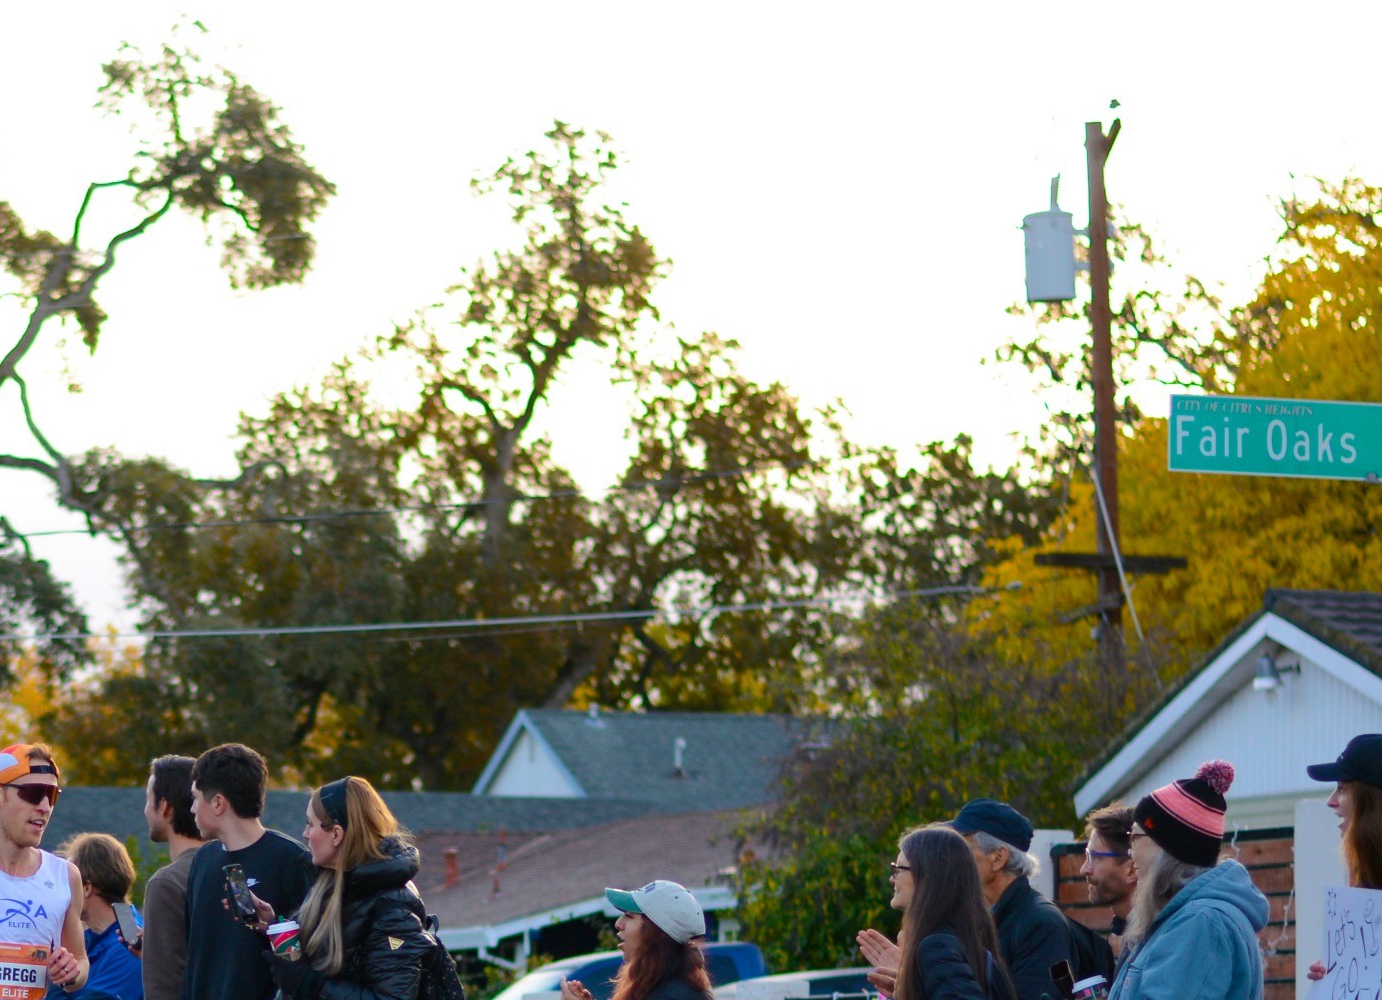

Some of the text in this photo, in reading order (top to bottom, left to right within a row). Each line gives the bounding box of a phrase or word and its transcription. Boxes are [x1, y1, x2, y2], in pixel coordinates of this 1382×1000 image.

[1176, 399, 1313, 417] CITY OF CITRUS HEIGHTS
[1176, 414, 1357, 464] Fair Oaks
[8, 921, 31, 929] ELITE
[1, 987, 29, 999] ELITE
